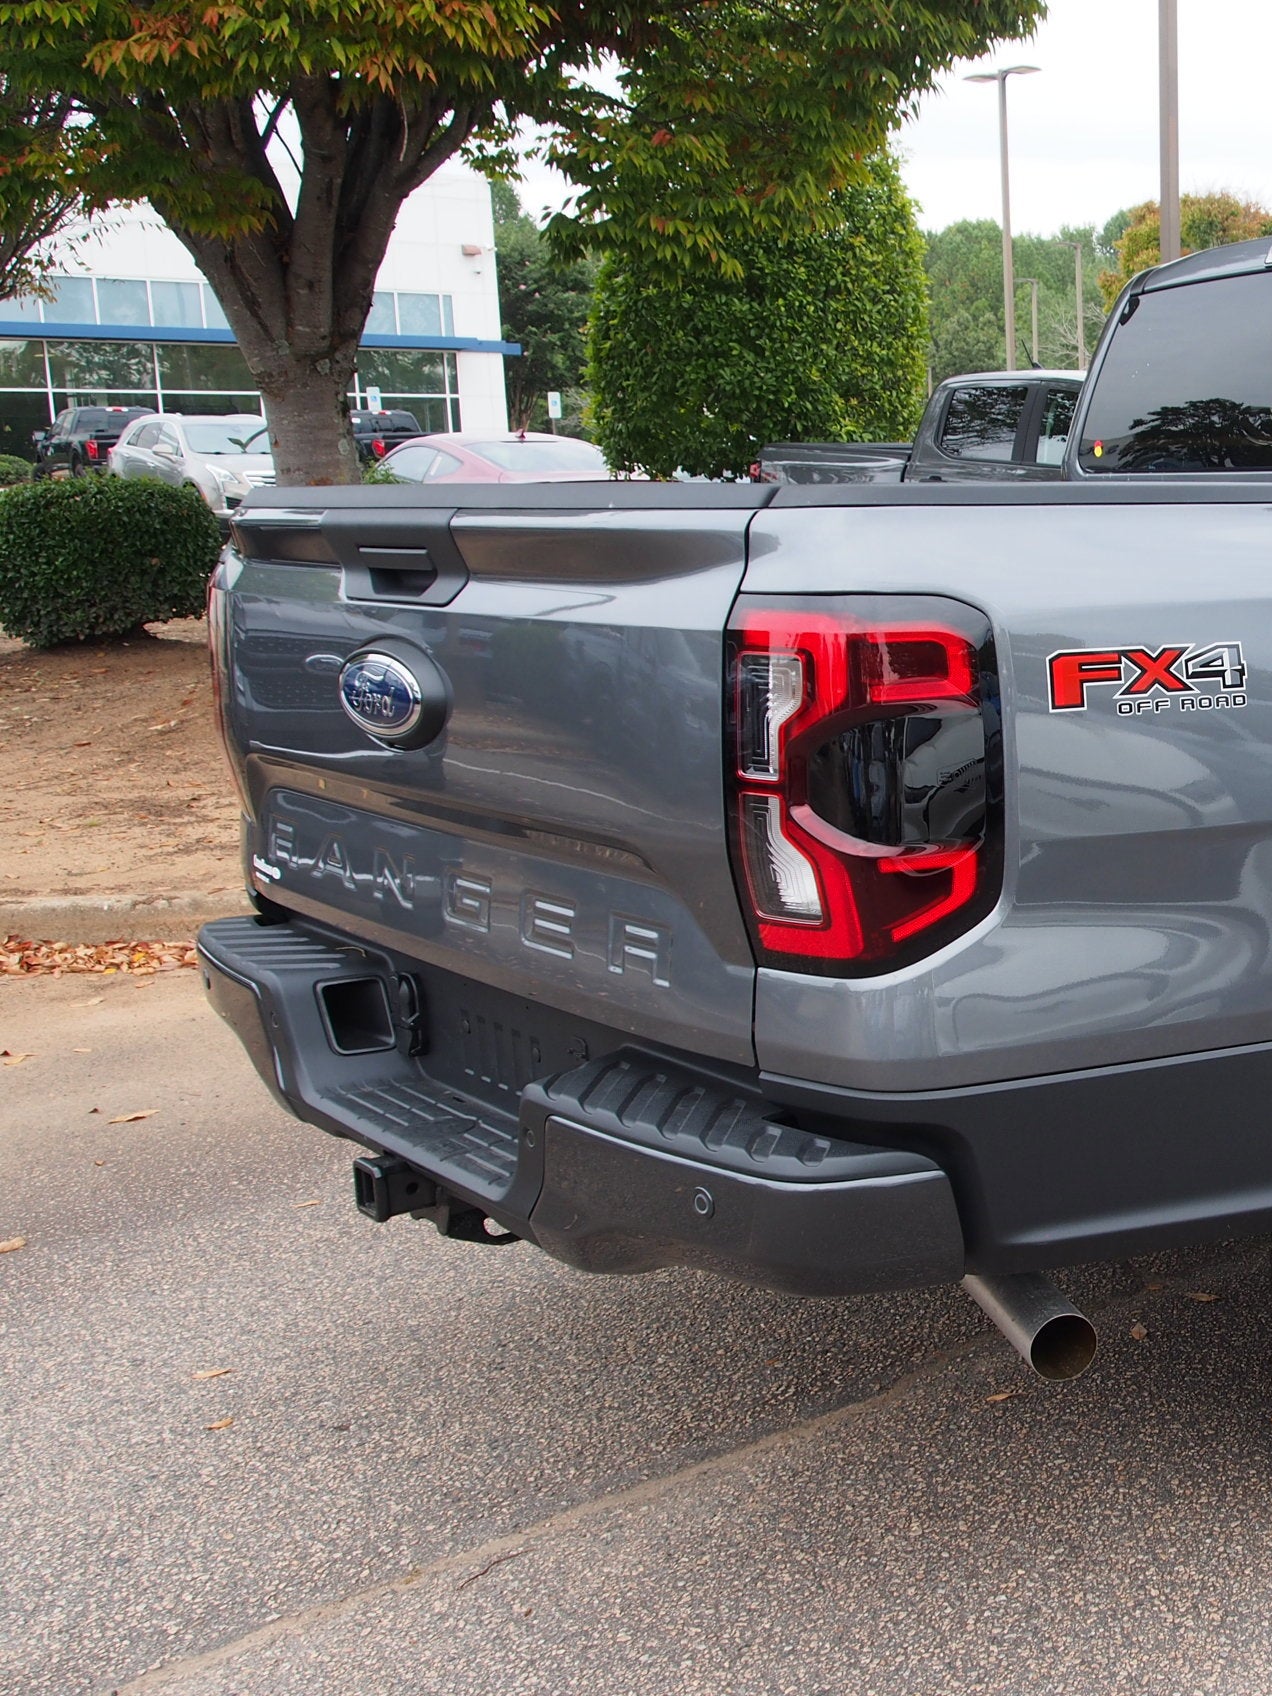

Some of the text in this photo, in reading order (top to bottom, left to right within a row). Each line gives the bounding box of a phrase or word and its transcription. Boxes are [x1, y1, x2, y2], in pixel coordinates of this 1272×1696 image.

[349, 670, 395, 718] Ford
[1046, 641, 1248, 713] FX4
[1117, 694, 1248, 716] OFF ROAD
[268, 812, 673, 989] RANGER
